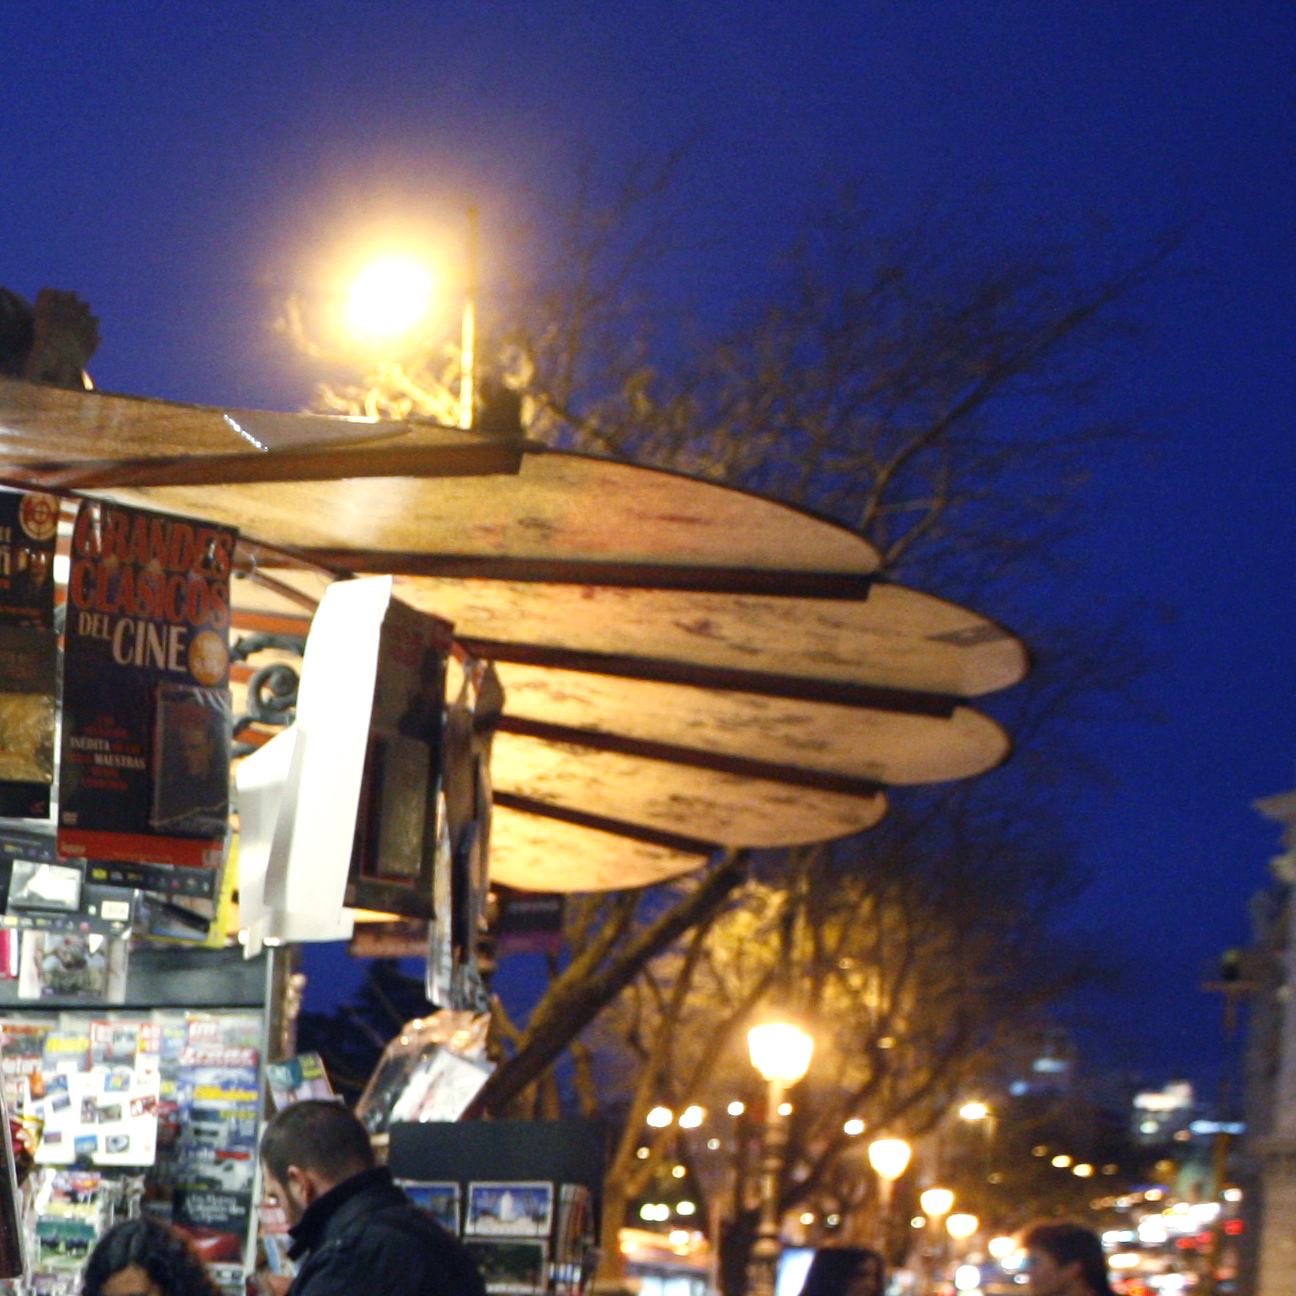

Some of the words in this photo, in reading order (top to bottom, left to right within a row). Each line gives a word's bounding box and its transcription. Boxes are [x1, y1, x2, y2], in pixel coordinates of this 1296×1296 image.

[75, 503, 235, 581] GRANDES
[78, 611, 112, 641] DEL
[112, 618, 188, 672] CINE
